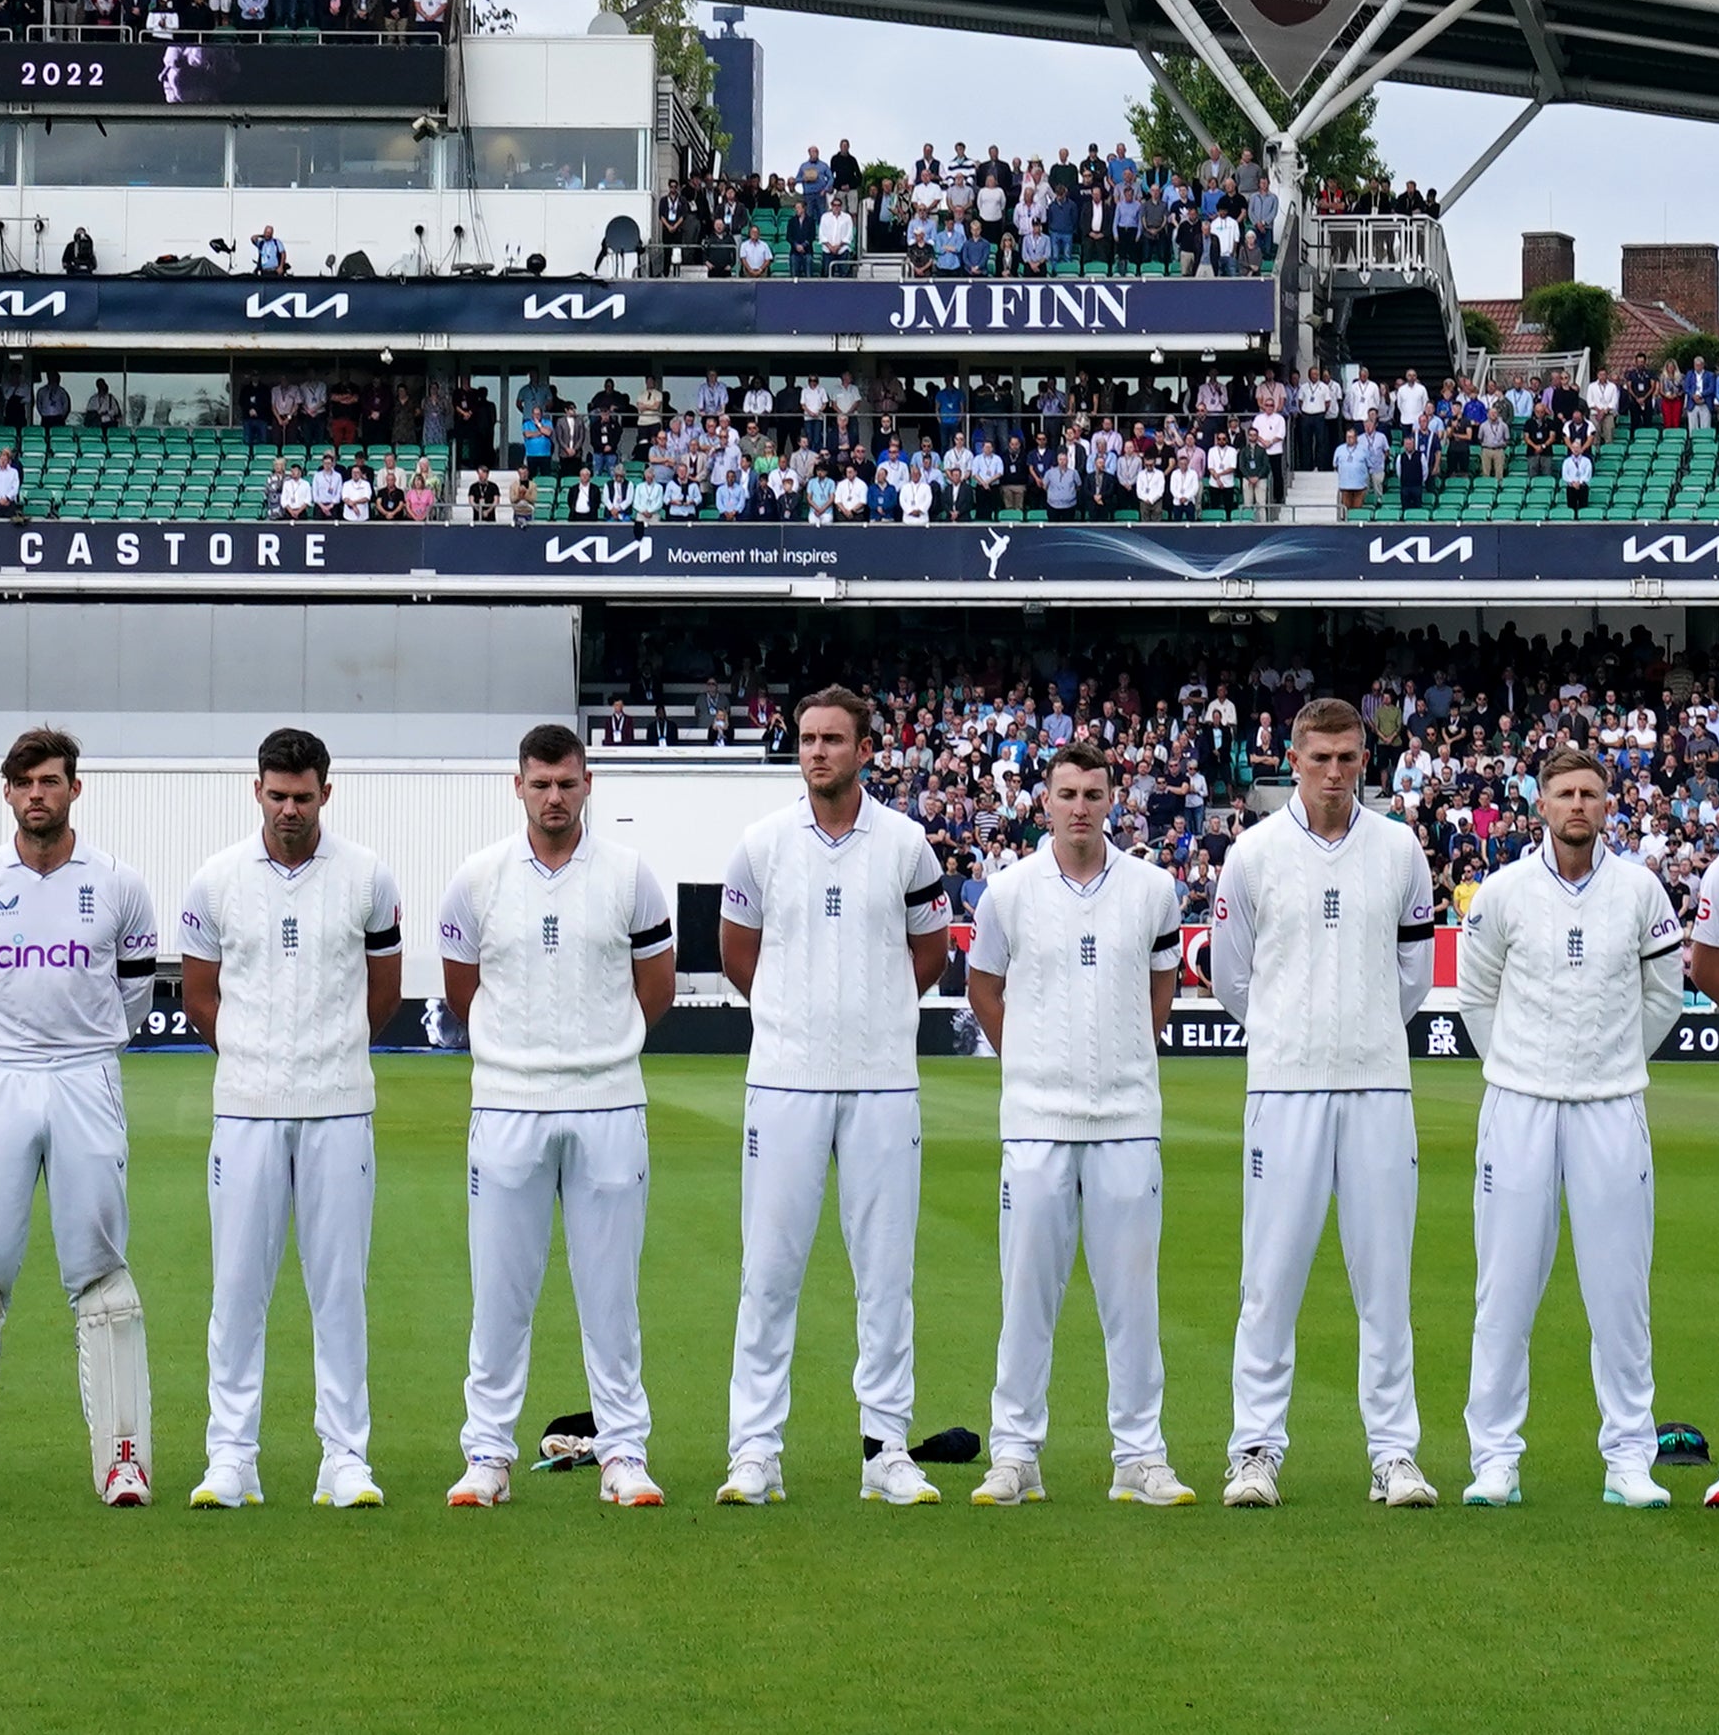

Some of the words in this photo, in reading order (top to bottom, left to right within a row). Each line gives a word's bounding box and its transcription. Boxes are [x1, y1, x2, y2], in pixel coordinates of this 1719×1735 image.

[21, 62, 104, 86] 2022
[889, 284, 970, 328] JM
[988, 284, 1132, 328] FINN
[20, 532, 327, 567] CASTORE
[668, 547, 746, 564] Movement
[749, 547, 778, 565] that
[782, 548, 838, 569] inspires
[1215, 897, 1228, 920] G
[1696, 898, 1711, 921] G
[1183, 1023, 1249, 1047] ELIZ
